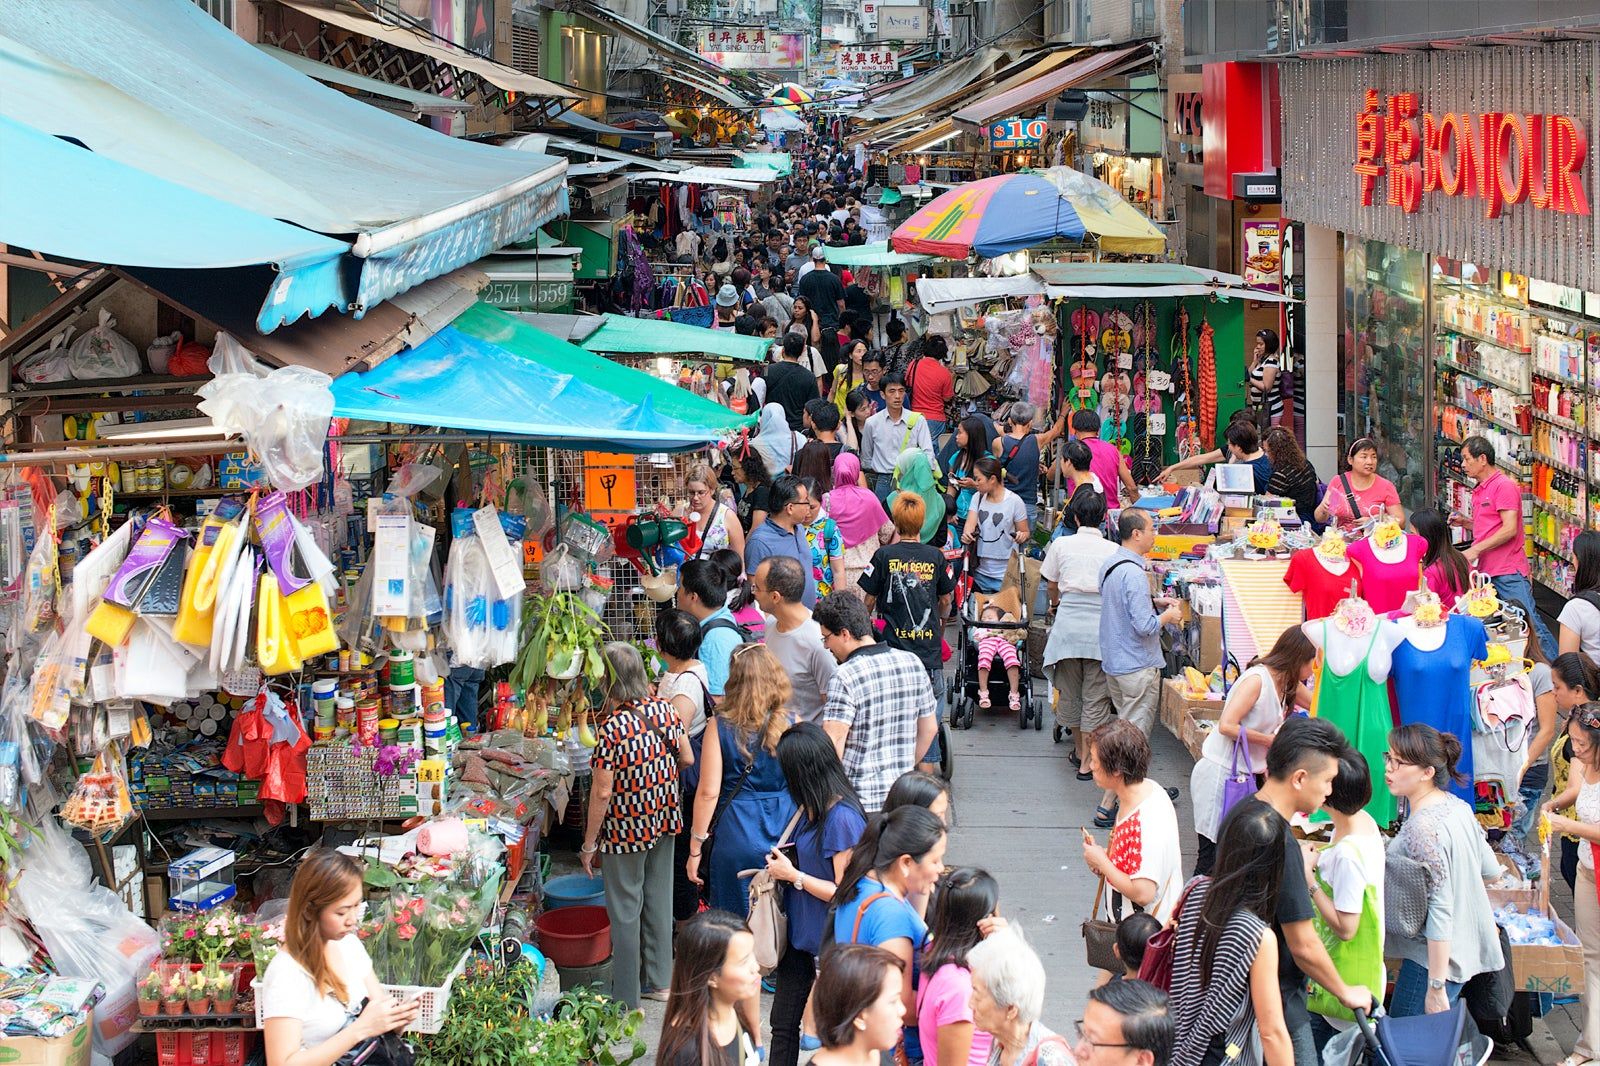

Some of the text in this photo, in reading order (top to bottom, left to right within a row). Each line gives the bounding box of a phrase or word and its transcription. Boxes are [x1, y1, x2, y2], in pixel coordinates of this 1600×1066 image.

[708, 31, 766, 44] 日昇玩具
[841, 52, 895, 65] 鴻興玩具
[1424, 112, 1590, 219] BONJOUR
[1265, 186, 1275, 194] 112
[484, 283, 568, 304] 2574 0559
